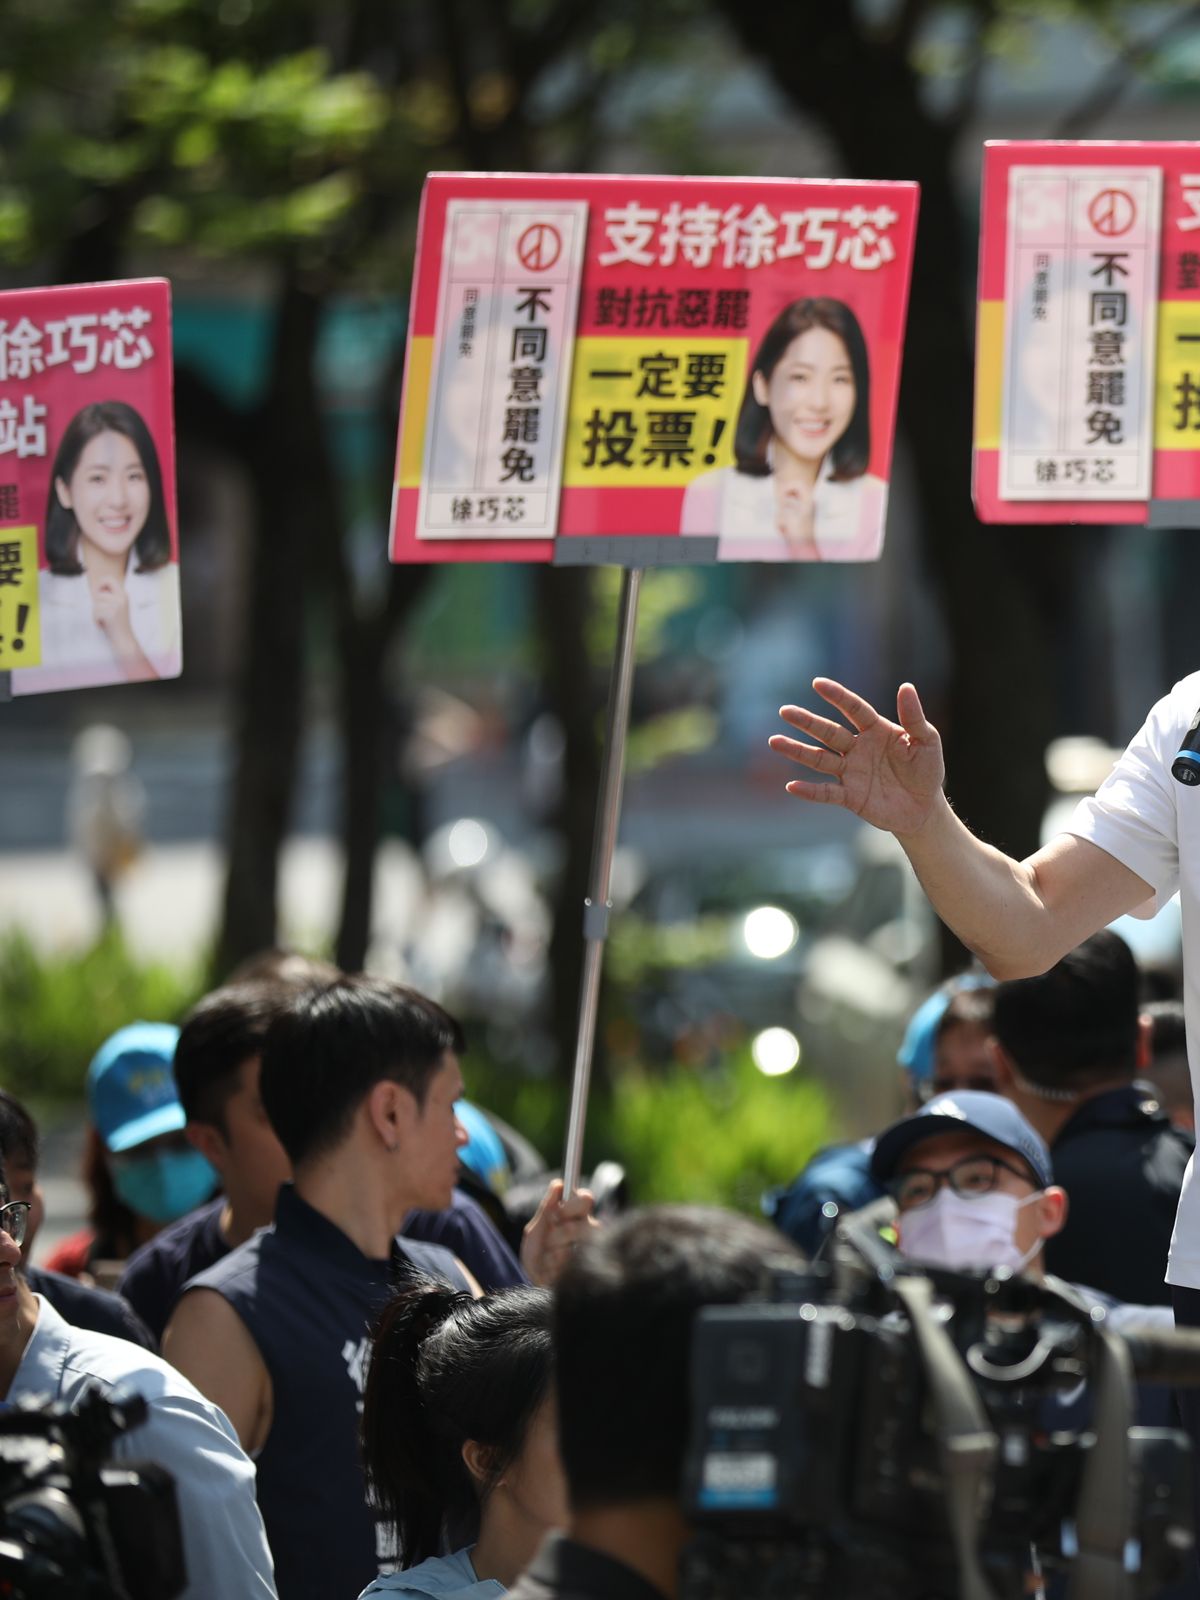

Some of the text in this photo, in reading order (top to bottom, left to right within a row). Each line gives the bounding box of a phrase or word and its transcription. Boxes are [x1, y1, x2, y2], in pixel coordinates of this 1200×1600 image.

[598, 202, 898, 270] 支持徐巧芯
[592, 286, 752, 332] 對抗惡罷
[588, 351, 728, 400] 一定要
[1084, 250, 1130, 446] 不同意罷免
[498, 286, 554, 484] 不同意罷免
[581, 409, 728, 470] 投票!
[1035, 459, 1116, 485] 徐巧芯
[450, 496, 526, 523] 徐巧芯
